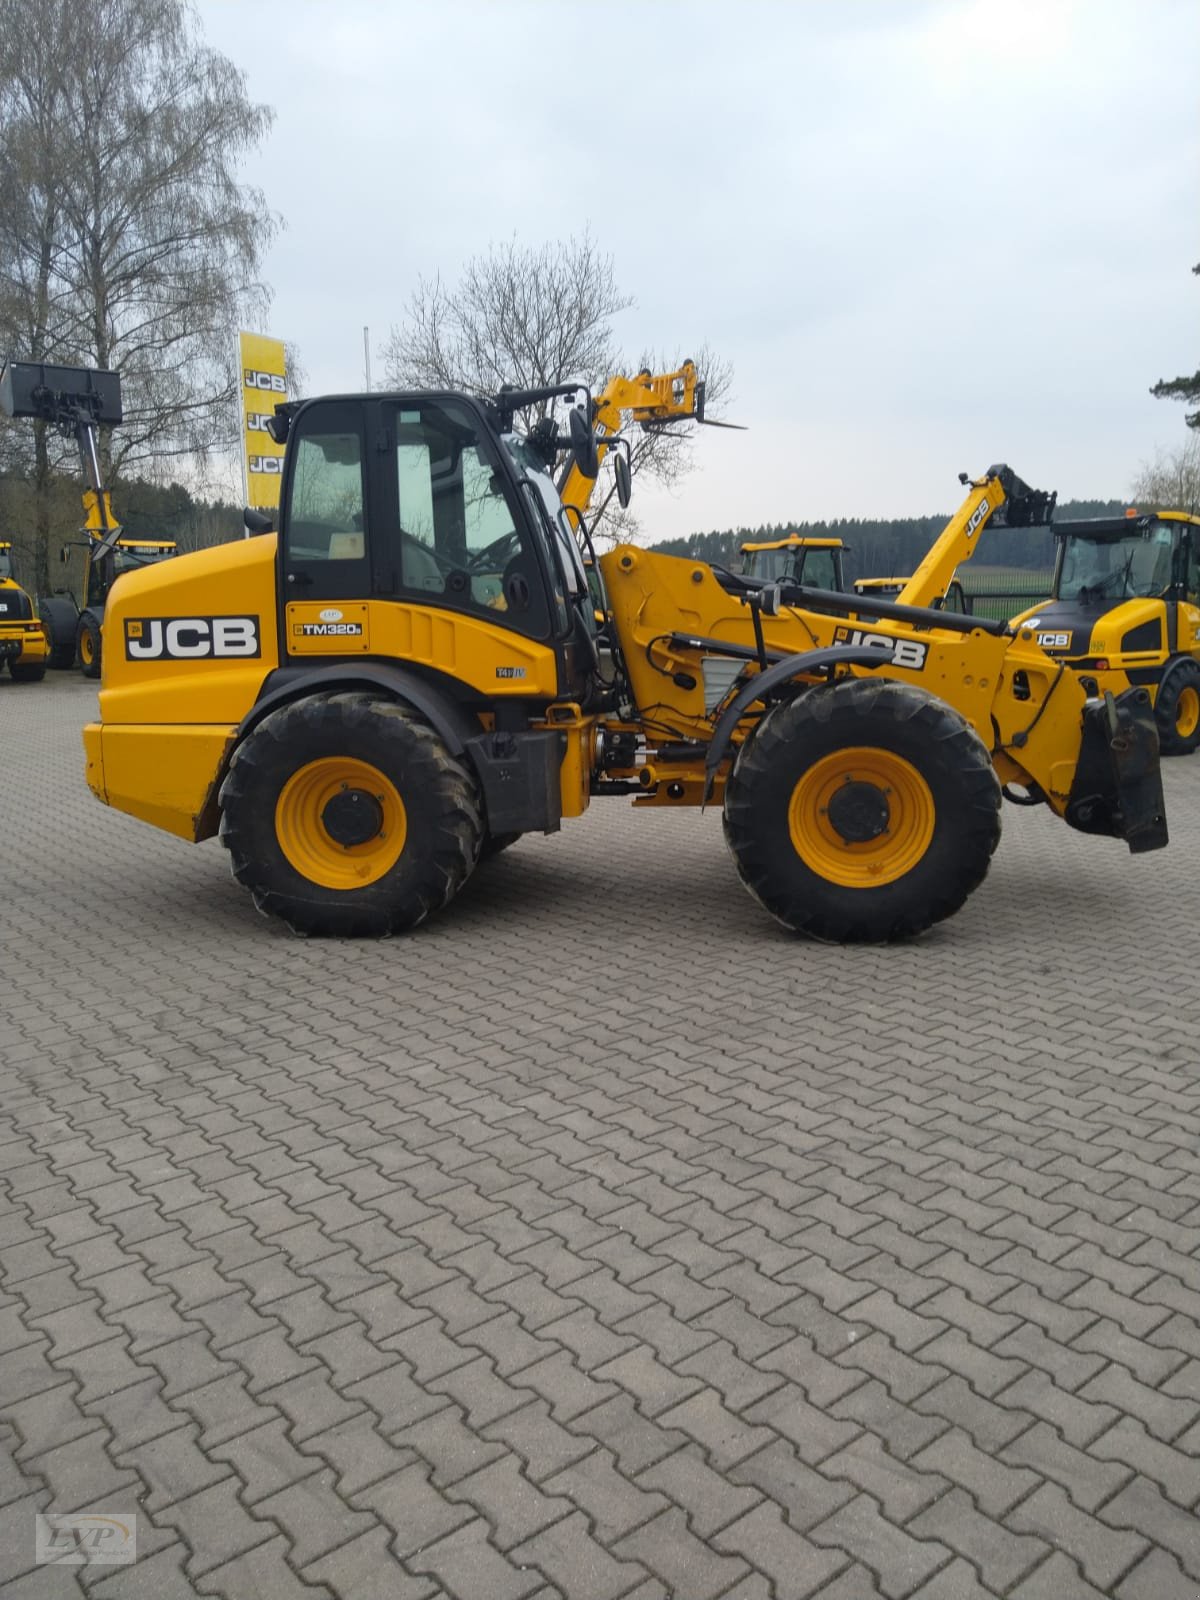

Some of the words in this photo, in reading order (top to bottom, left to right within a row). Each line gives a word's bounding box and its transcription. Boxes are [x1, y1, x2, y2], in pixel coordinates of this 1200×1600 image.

[245, 371, 285, 392] JCB
[967, 499, 989, 537] JCB
[128, 619, 258, 658] JCB
